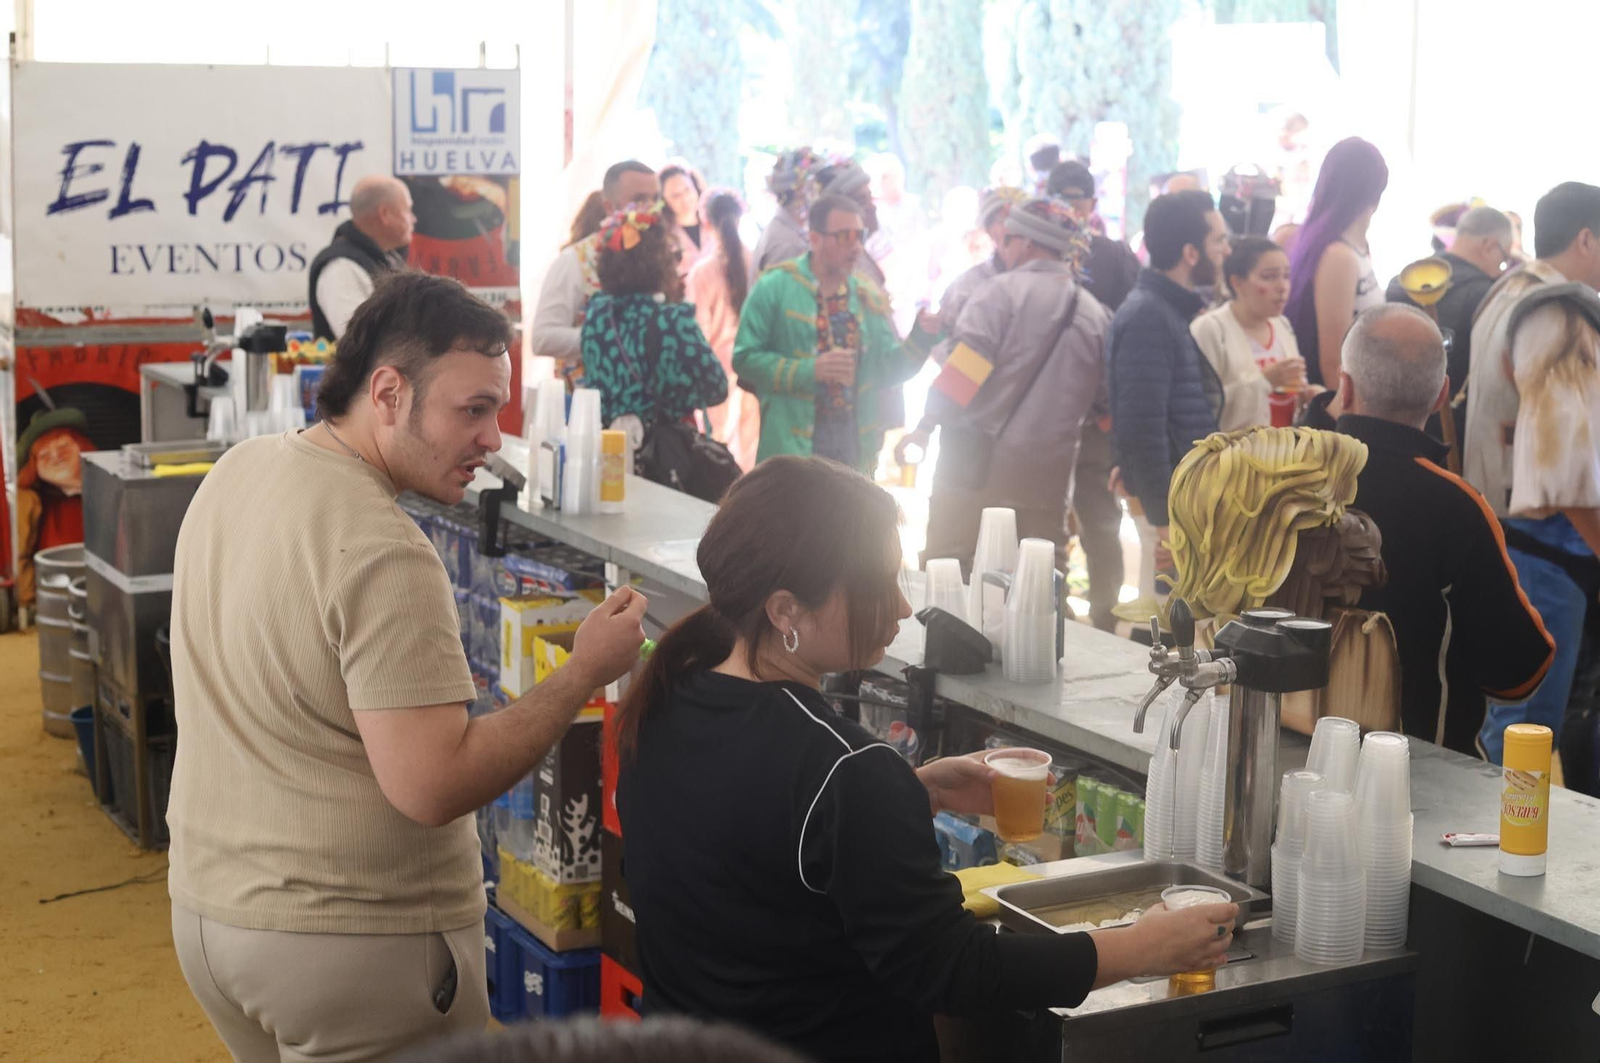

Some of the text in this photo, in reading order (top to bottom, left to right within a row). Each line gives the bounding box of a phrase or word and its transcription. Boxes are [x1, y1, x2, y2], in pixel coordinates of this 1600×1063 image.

[400, 150, 518, 171] HUELVA
[47, 140, 156, 220] EL
[109, 242, 308, 274] EVENTOS
[1055, 790, 1074, 810] pes
